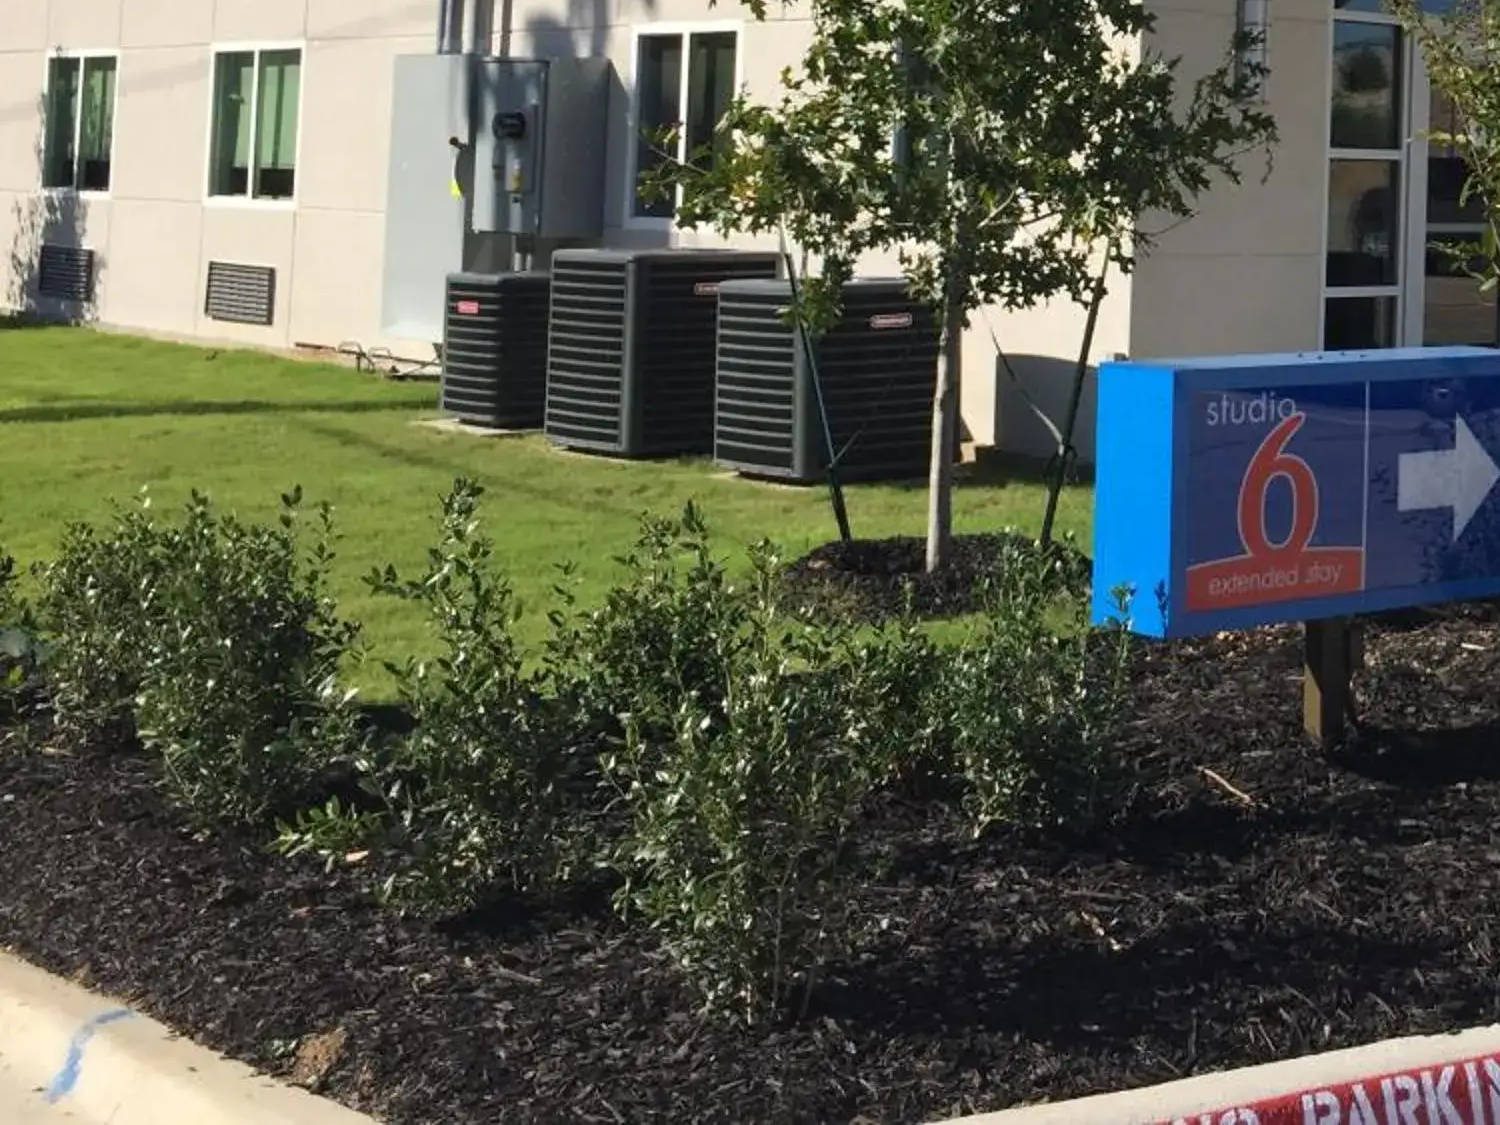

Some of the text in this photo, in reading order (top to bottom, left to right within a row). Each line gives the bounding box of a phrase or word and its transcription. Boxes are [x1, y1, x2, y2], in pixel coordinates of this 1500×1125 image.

[1206, 390, 1298, 426] studio
[1237, 410, 1320, 557] 6
[1208, 560, 1344, 596] extended stay
